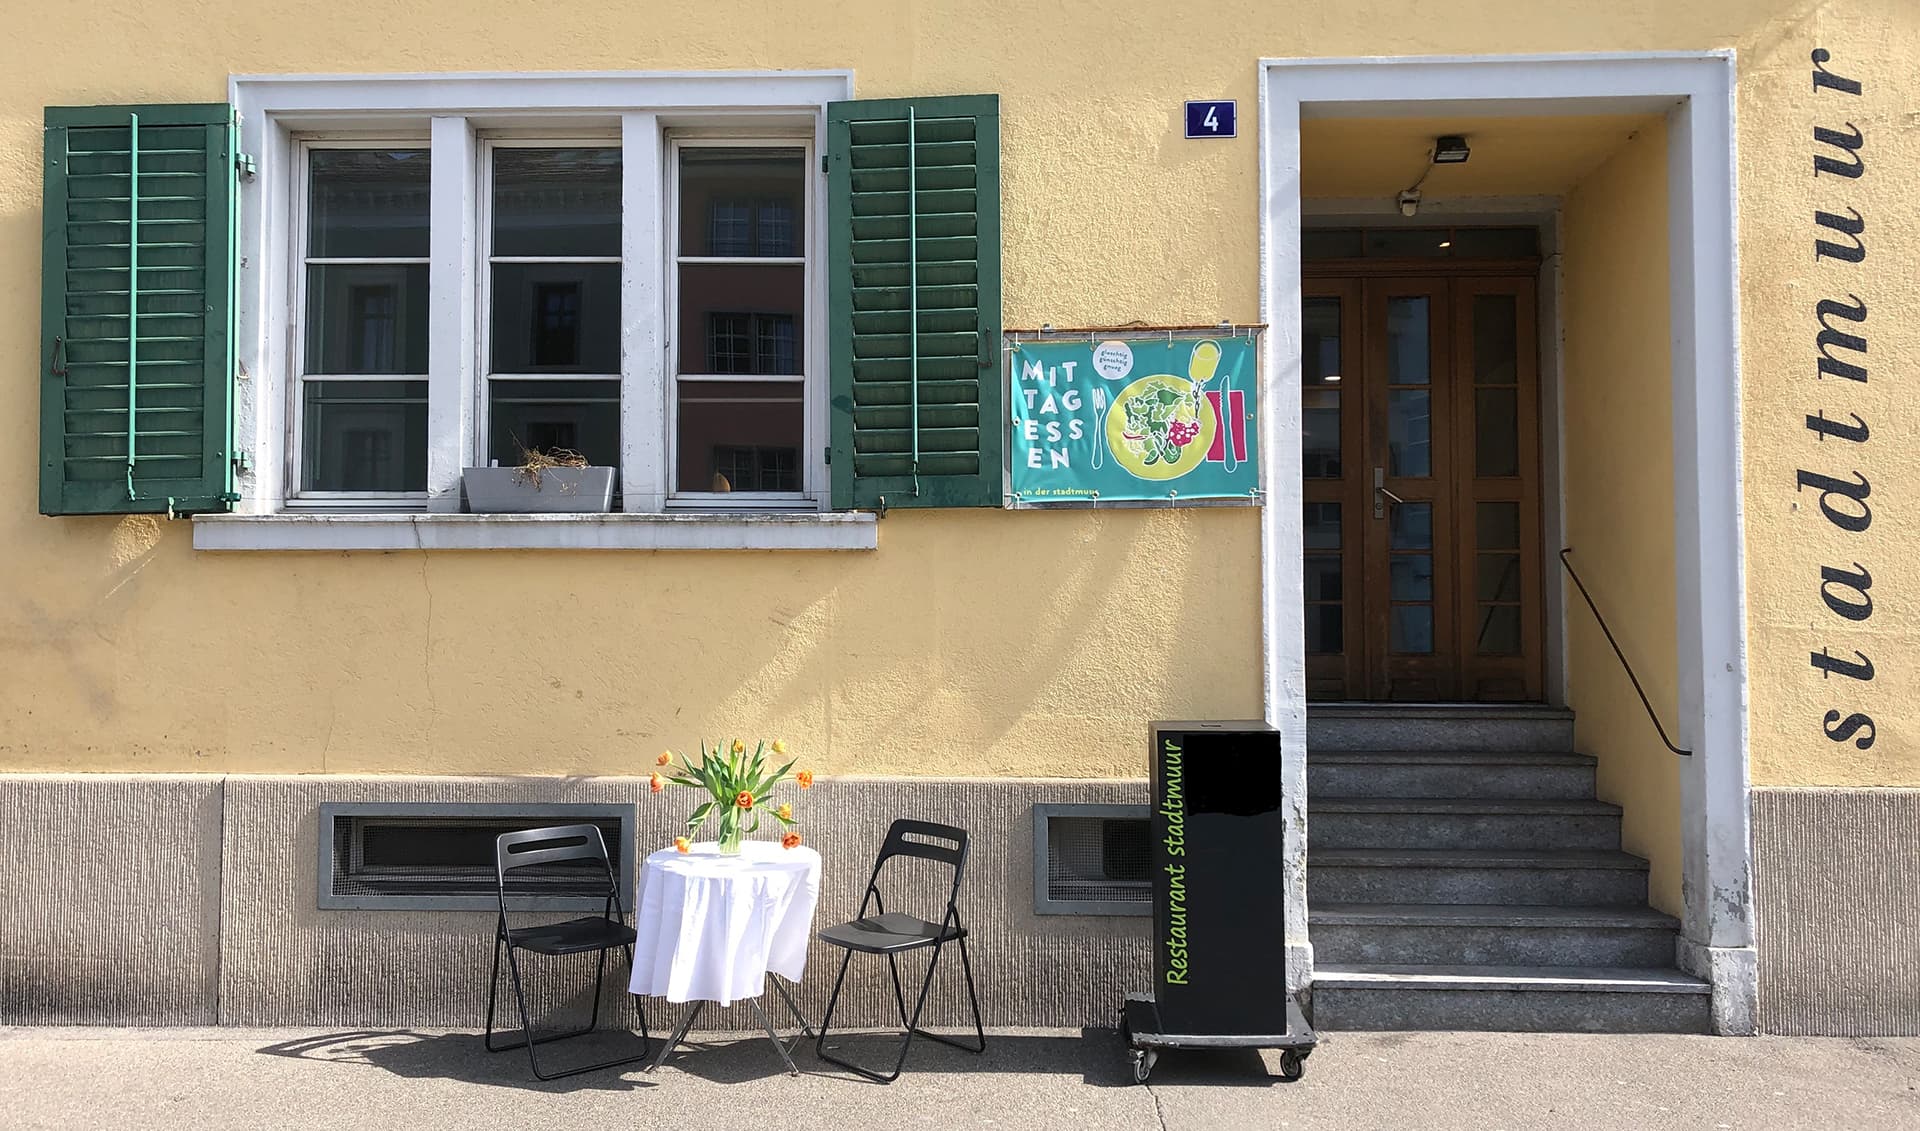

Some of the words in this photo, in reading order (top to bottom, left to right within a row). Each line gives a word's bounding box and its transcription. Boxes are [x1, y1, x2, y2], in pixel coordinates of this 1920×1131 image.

[1203, 106, 1219, 132] 4
[1021, 359, 1078, 387] MIT
[1023, 389, 1082, 414] TAG
[1796, 48, 1876, 750] stadtmuur
[1024, 419, 1084, 443] ESS
[1027, 447, 1070, 469] EN
[1023, 487, 1032, 496] in
[1035, 487, 1050, 496] der
[1053, 486, 1098, 496] stadtmuu
[1159, 739, 1185, 857] stadtmuur
[1164, 863, 1188, 985] Restaurant
